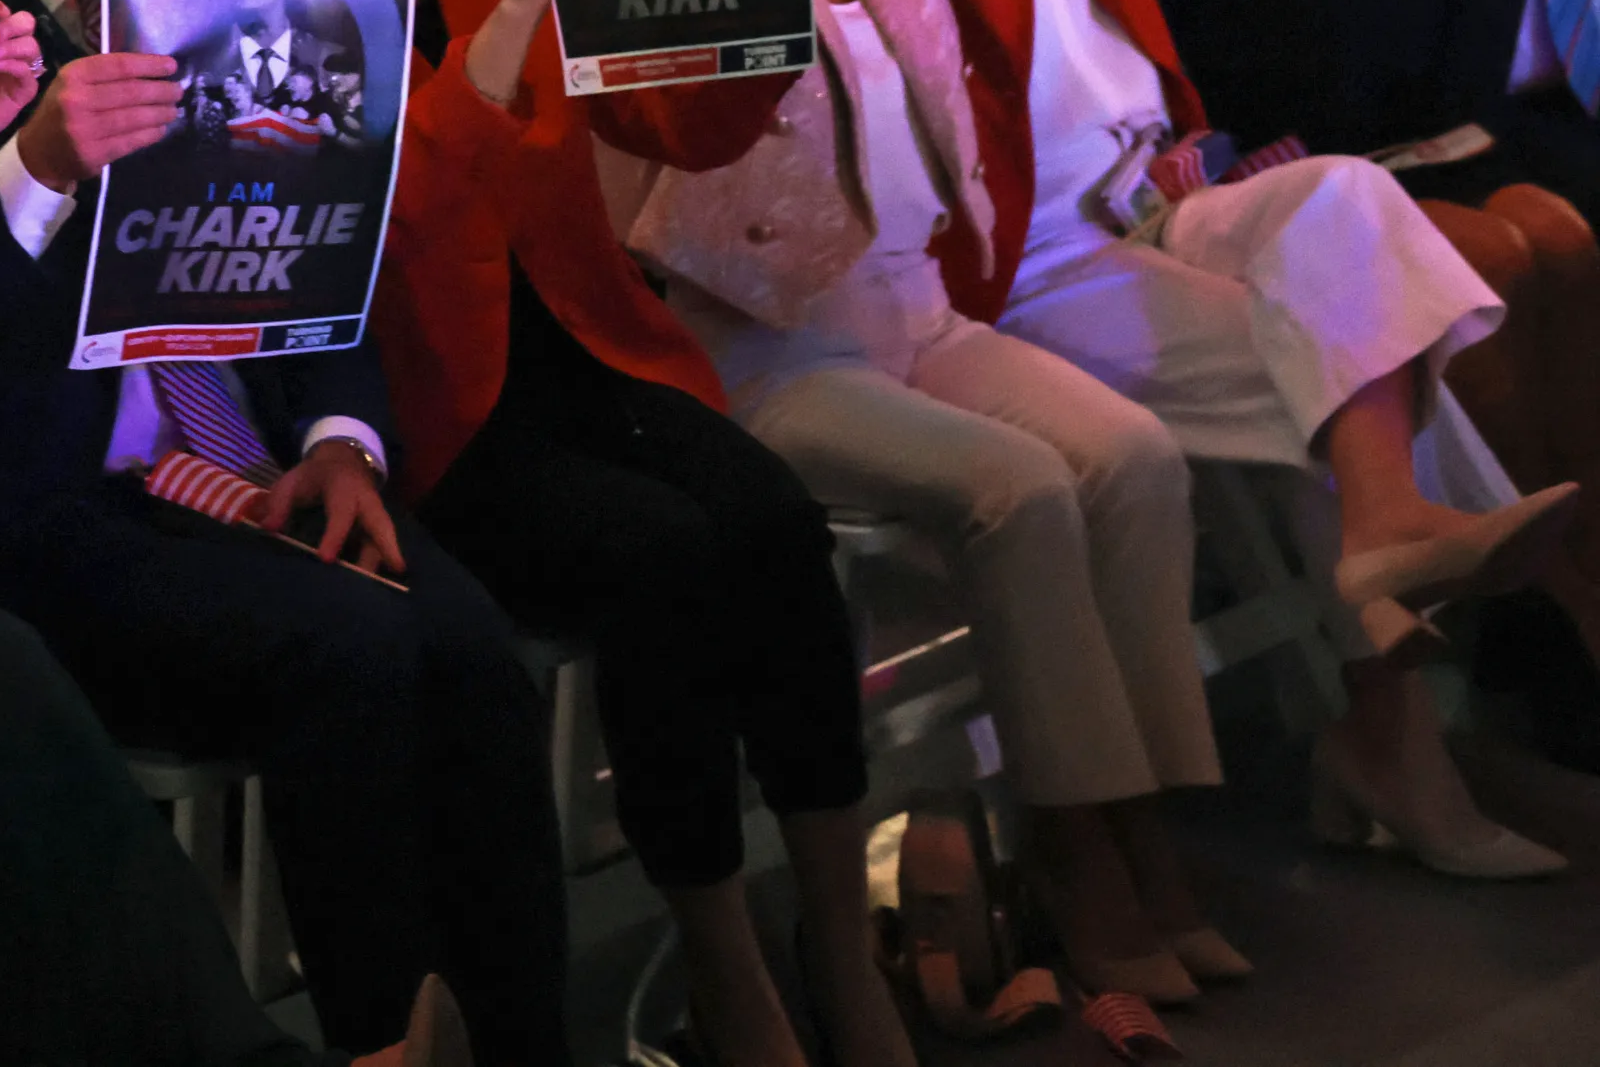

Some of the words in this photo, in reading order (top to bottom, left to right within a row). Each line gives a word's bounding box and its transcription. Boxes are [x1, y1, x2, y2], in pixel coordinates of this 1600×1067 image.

[207, 182, 216, 203] I
[227, 181, 276, 203] AM
[115, 203, 366, 255] CHARLIE
[156, 249, 305, 294] KIRK
